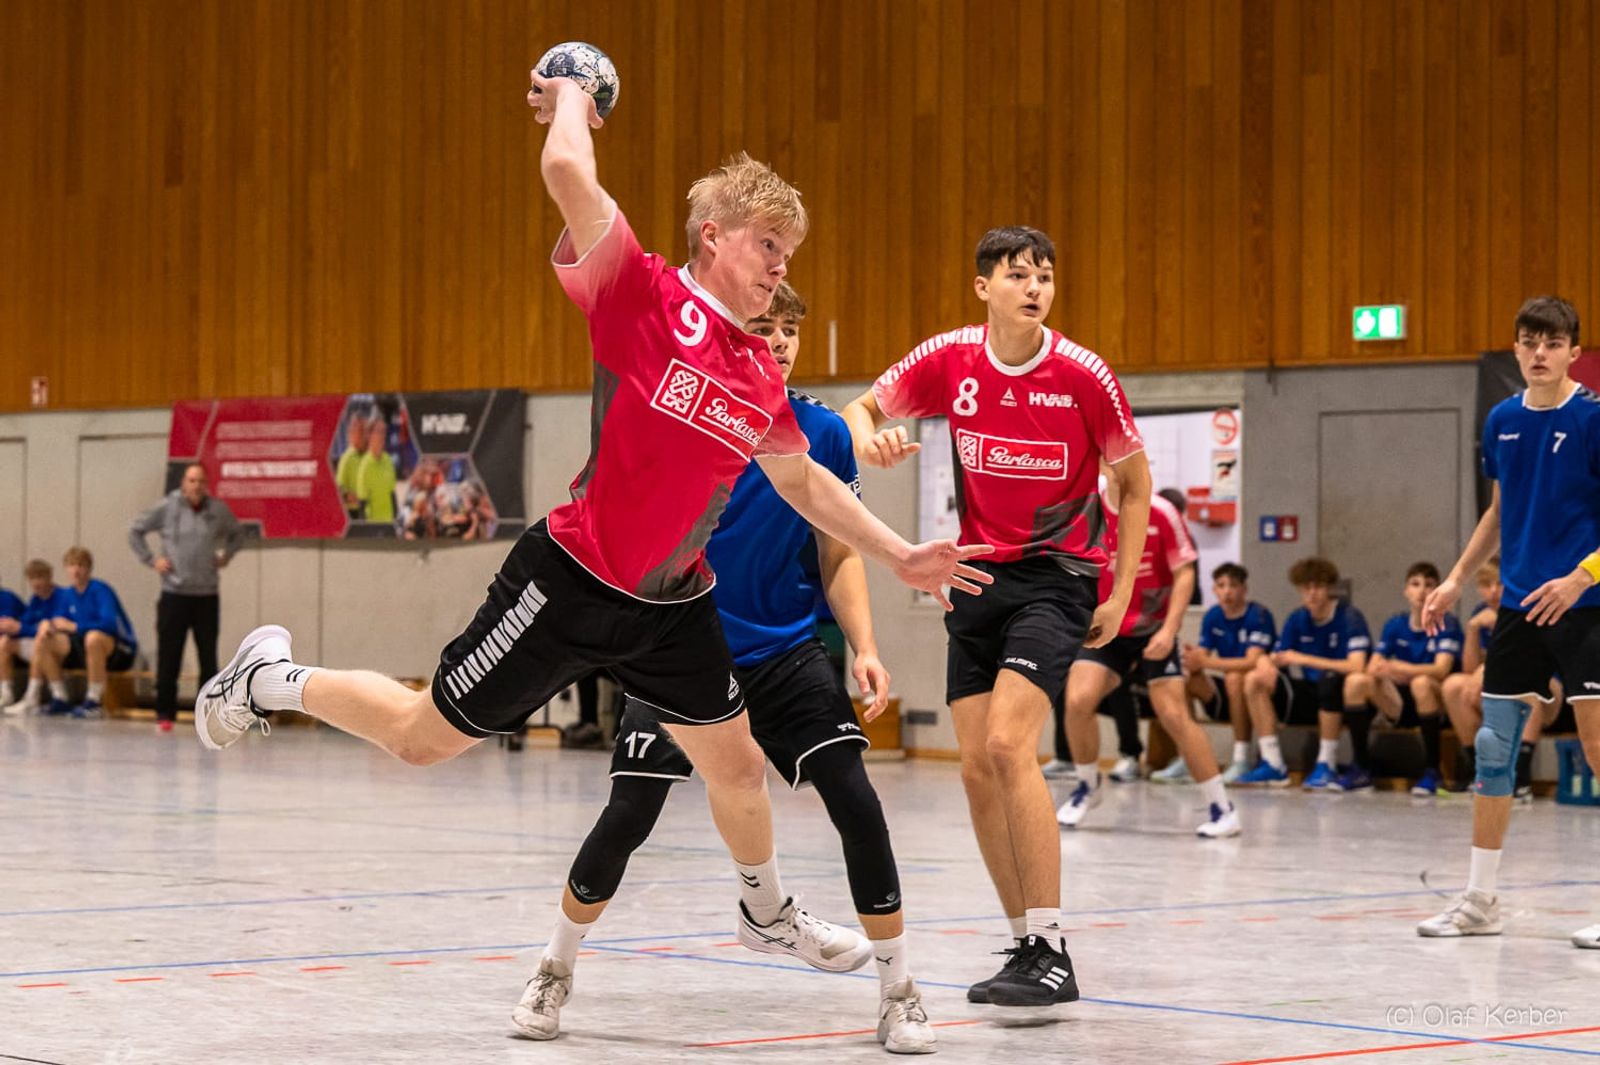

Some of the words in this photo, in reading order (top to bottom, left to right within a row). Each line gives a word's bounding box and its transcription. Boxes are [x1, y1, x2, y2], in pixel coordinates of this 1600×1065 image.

[673, 300, 708, 347] 9
[952, 377, 979, 417] 8
[1552, 431, 1567, 453] 7
[986, 446, 1064, 468] Parlasca
[625, 731, 657, 759] 17
